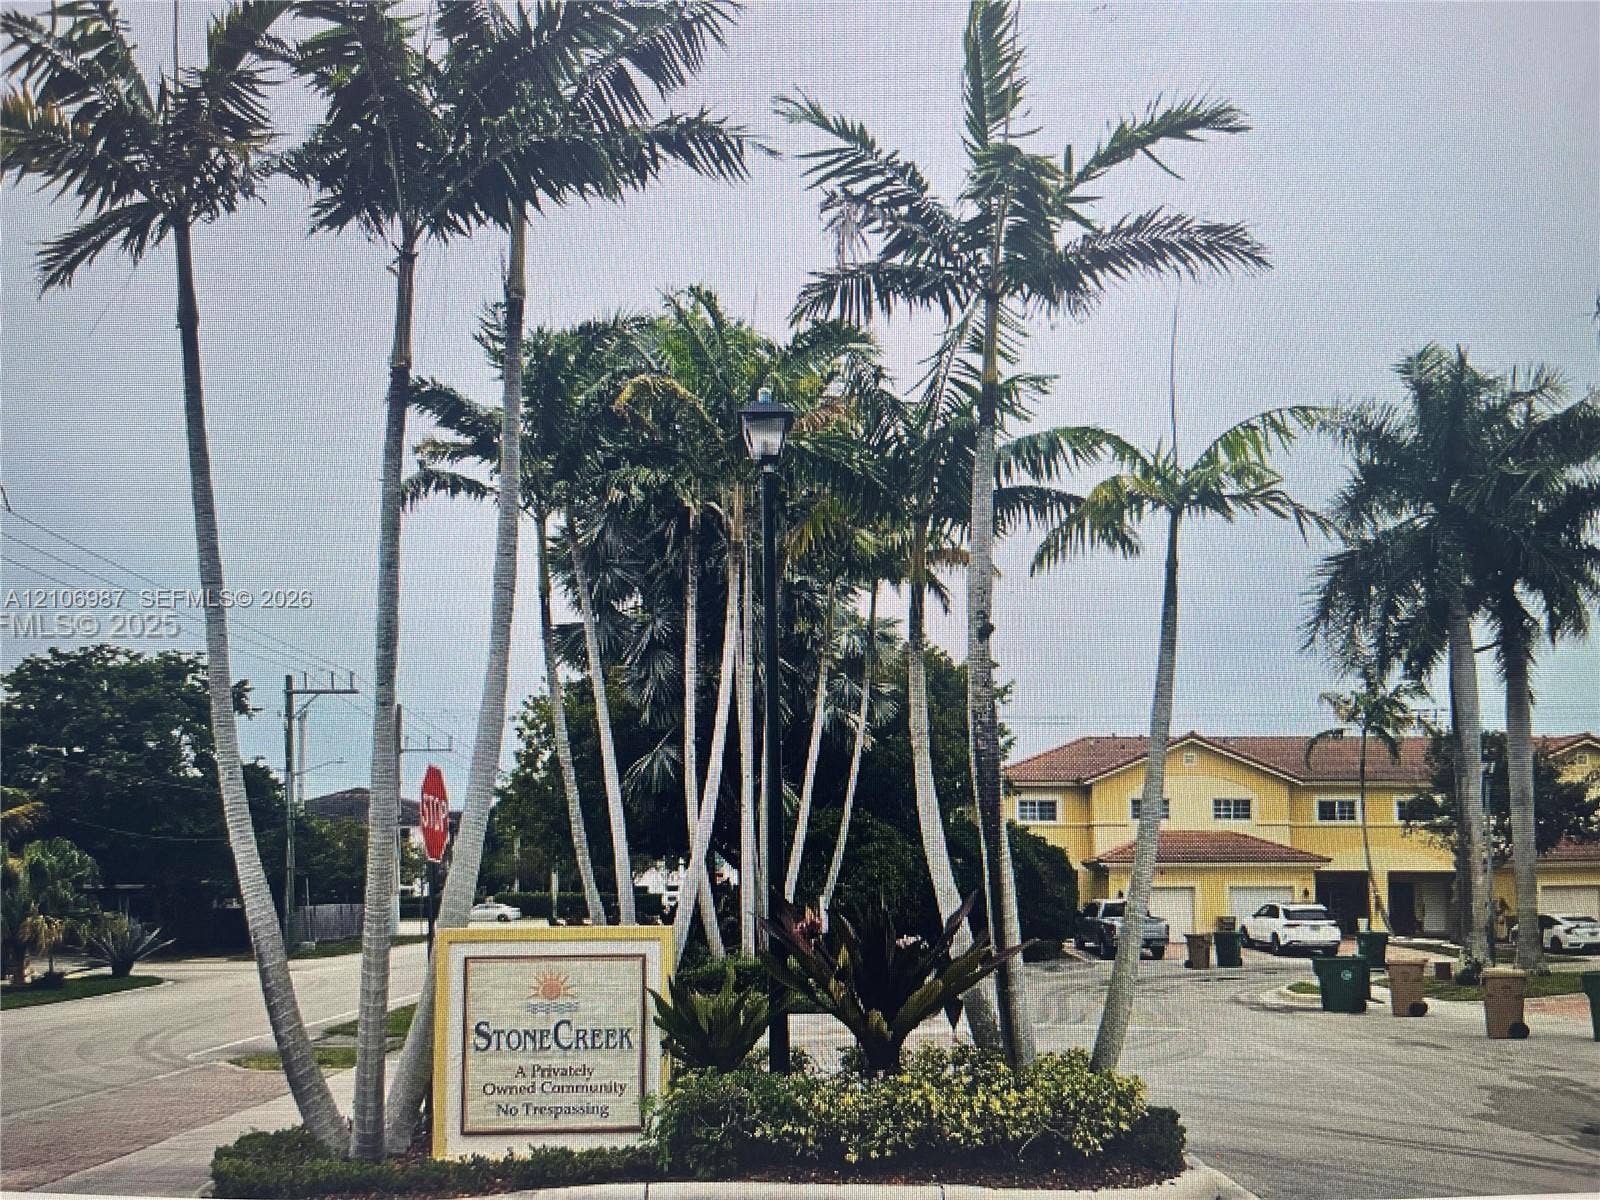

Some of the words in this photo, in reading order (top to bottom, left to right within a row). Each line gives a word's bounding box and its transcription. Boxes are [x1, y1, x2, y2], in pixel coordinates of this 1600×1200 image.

[421, 793, 449, 832] STOP
[515, 1066, 526, 1078] A
[531, 1064, 595, 1082] Privately
[482, 1081, 537, 1096] Owned
[541, 1080, 627, 1099] Community
[496, 1102, 517, 1116] No
[522, 1101, 609, 1119] Trespassing
